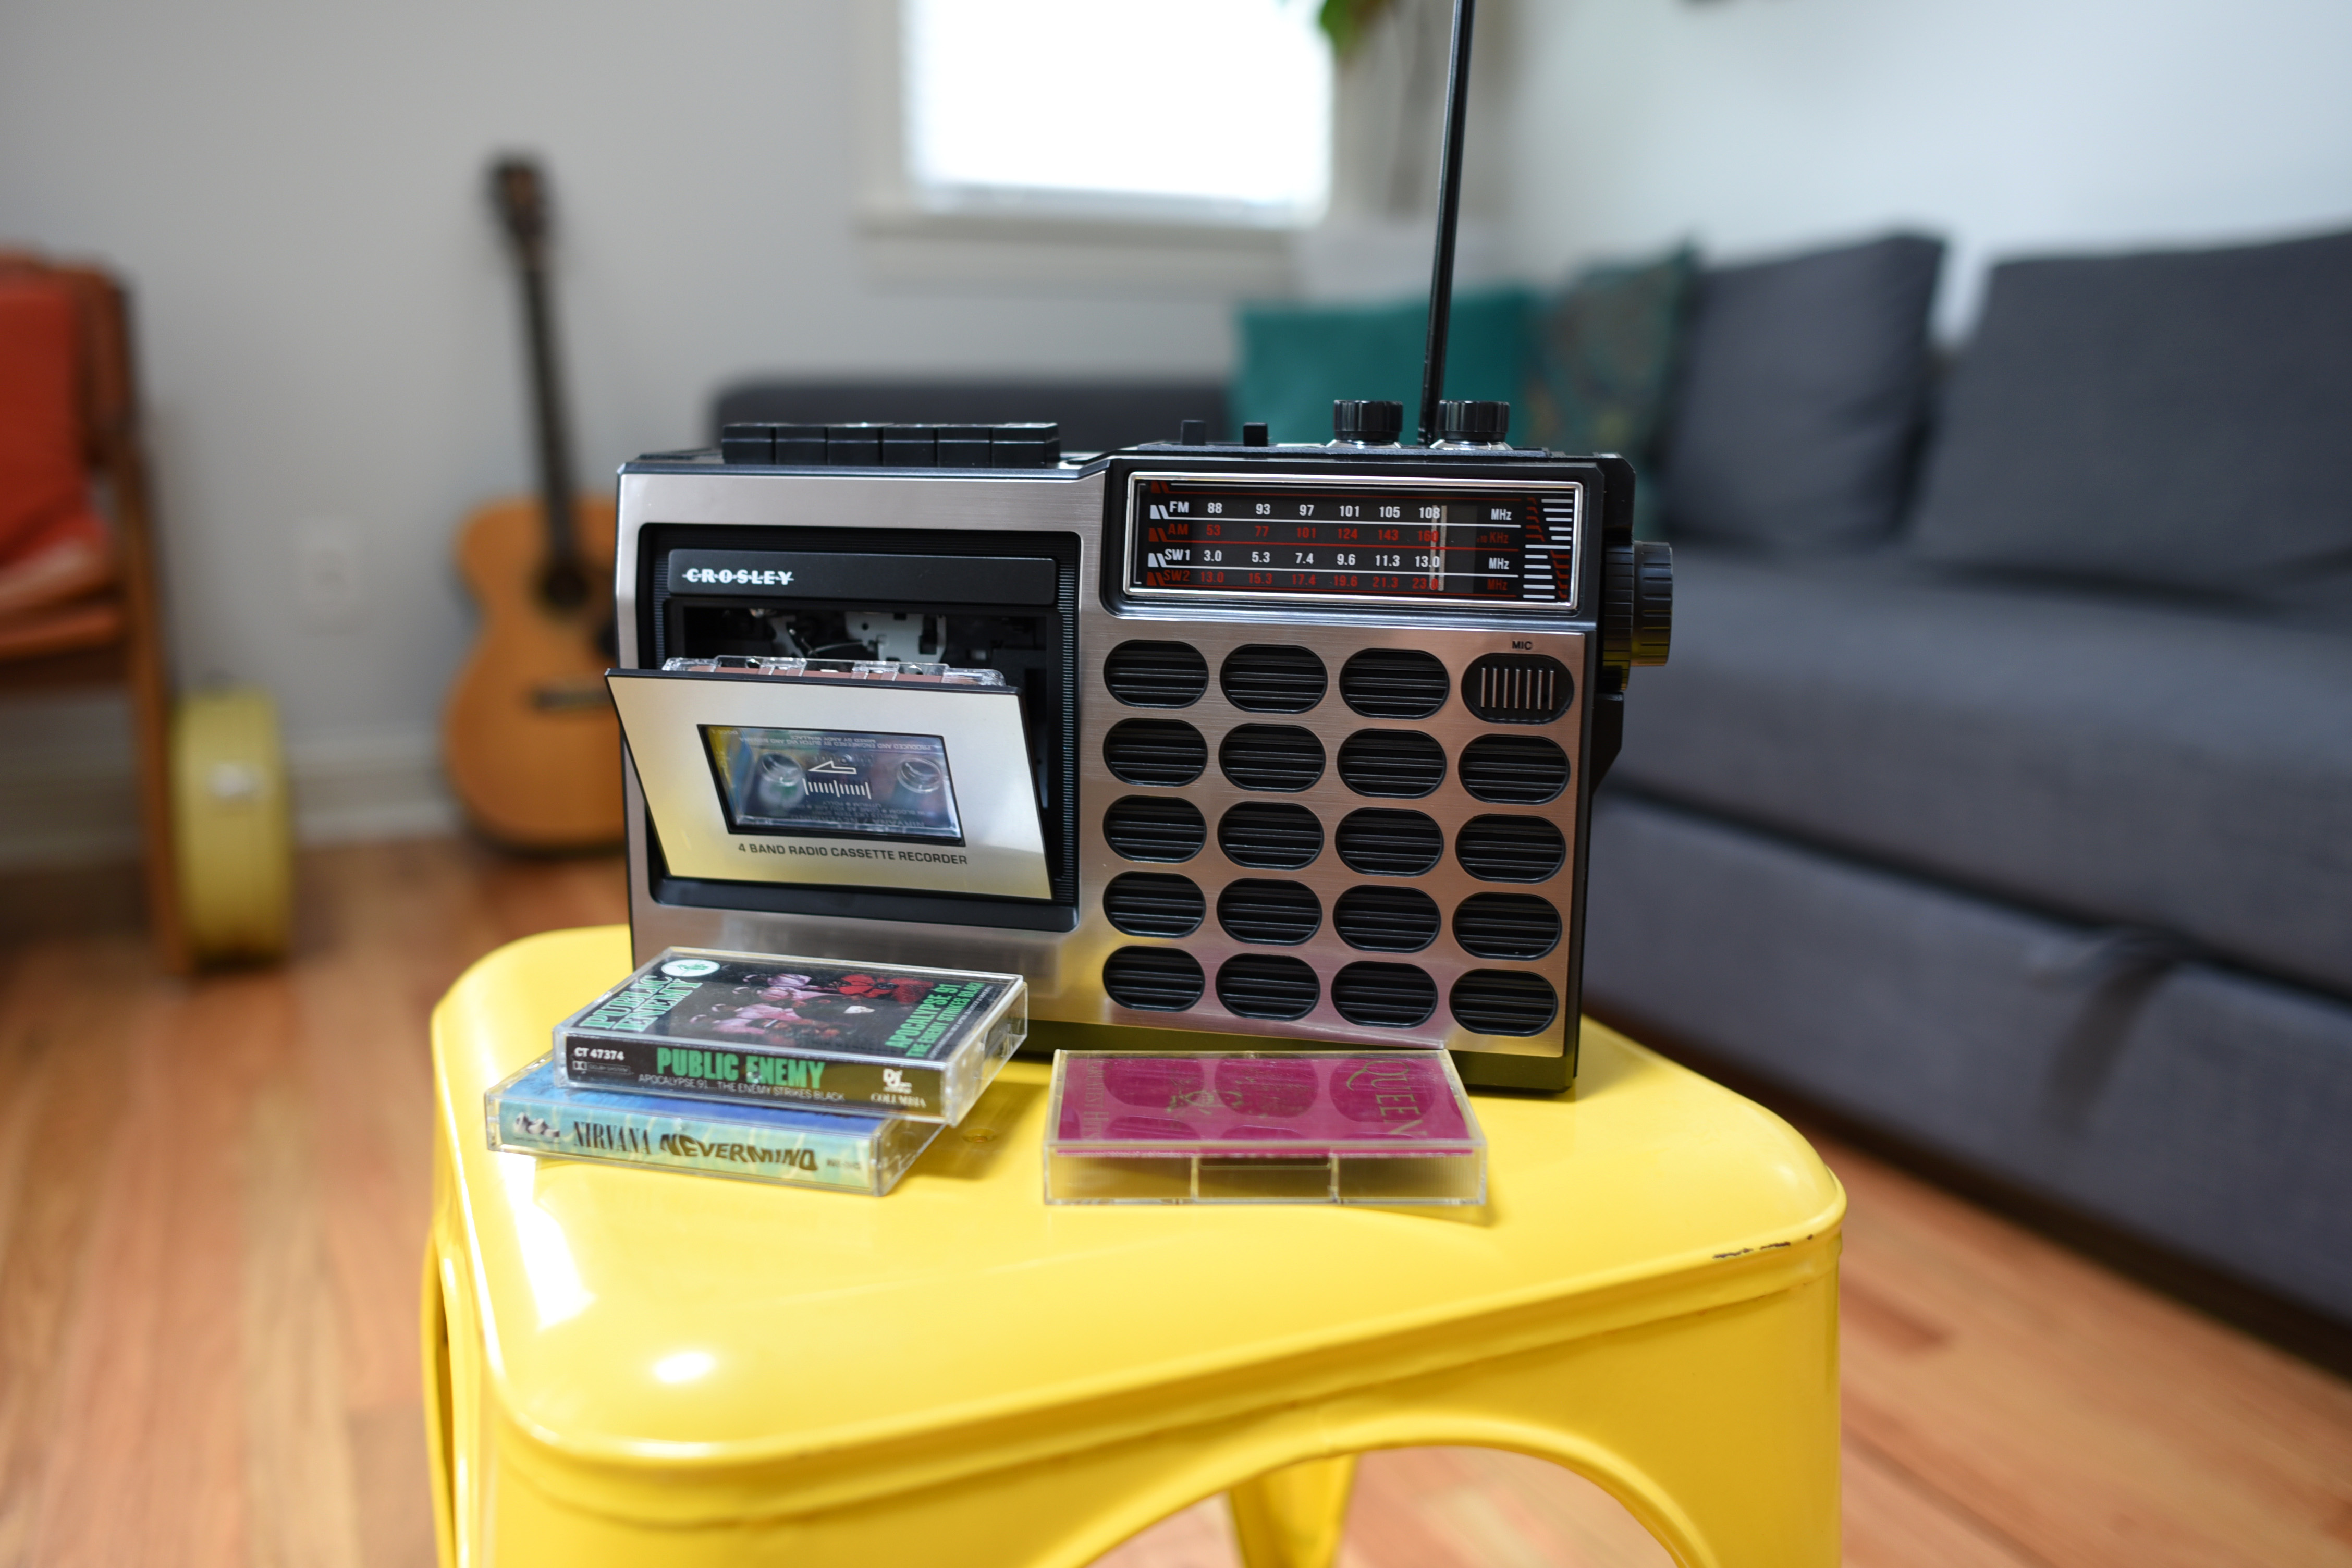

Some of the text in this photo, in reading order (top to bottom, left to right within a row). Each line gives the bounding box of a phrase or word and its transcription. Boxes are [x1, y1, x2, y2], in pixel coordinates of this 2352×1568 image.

[1169, 501, 1512, 521] FM 88 93 97 101 105 108 MHz
[1168, 523, 1189, 536] AM
[1206, 524, 1221, 536] 53
[1255, 525, 1269, 537] 77
[1296, 527, 1316, 539] 101
[1338, 528, 1358, 540] 124
[1378, 529, 1399, 541] 143
[1418, 530, 1439, 543] 160
[1489, 532, 1509, 544] KHz
[1164, 548, 1510, 570] SW1 3.0 5.3 7.4 9.6 11.3 13.0 MHz
[682, 568, 794, 585] CROSLEY
[1163, 570, 1508, 591] SW2 13.0 15.3 17.4 19.6 21.3 23.0 MHz
[1512, 641, 1533, 650] MIC
[738, 843, 968, 865] 4 BAND RADIO CASSETTE RECORDER
[579, 975, 704, 1033] PUBLIC ENEMY
[936, 997, 972, 1022] STRIKES
[884, 994, 953, 1049] APOCALYPSE
[933, 983, 962, 994] 91
[917, 1021, 950, 1043] ENEMY
[574, 1047, 626, 1061] CT 47374
[905, 1043, 932, 1058] THE
[657, 1047, 825, 1089] PUBLIC ENEMY
[638, 1073, 696, 1088] APOCALYPSE
[717, 1081, 737, 1092] THE
[738, 1083, 771, 1094] ENEMY
[772, 1086, 813, 1098] STRIKES
[813, 1090, 846, 1102] BLACK
[1346, 1059, 1428, 1136] QUEEN
[573, 1120, 818, 1172] NIRVANA NEVERMIND
